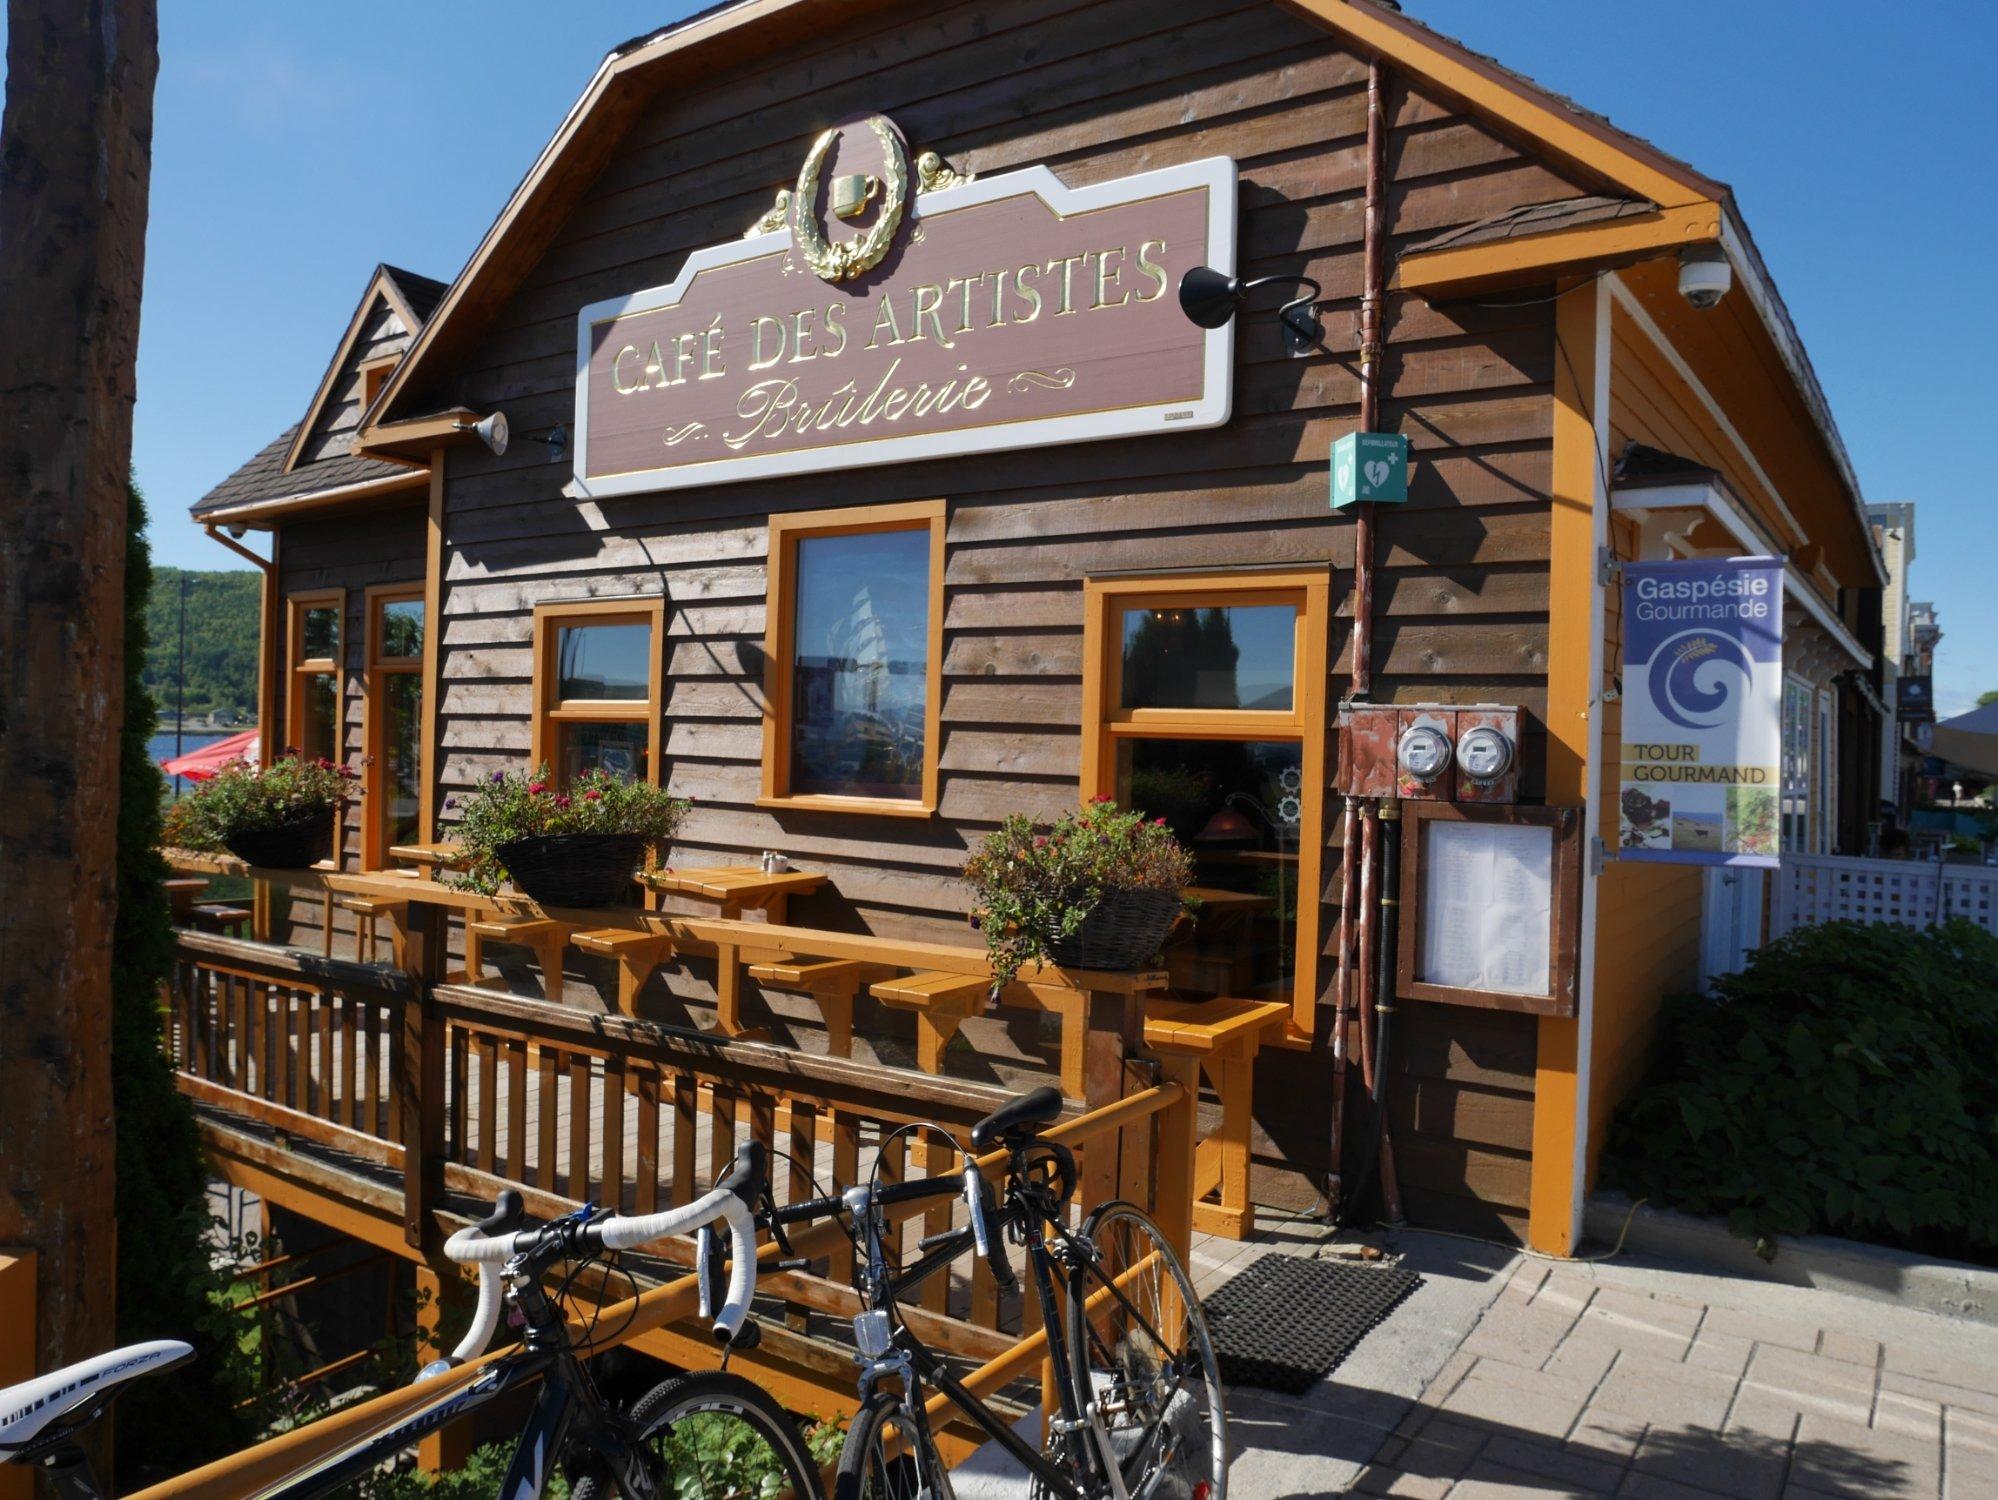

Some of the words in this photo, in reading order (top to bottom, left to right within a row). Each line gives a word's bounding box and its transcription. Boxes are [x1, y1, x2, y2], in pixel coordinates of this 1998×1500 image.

[611, 312, 727, 395] CAFÉ
[748, 302, 847, 371] DES
[864, 240, 1168, 350] ARTISTES
[722, 358, 992, 449] Brûlerie
[1636, 574, 1768, 602] Gaspésie
[1636, 599, 1768, 621] Gourmande
[1634, 744, 1695, 761] TOUR
[1634, 765, 1766, 784] GOURMAND
[102, 1351, 161, 1378] FORZA
